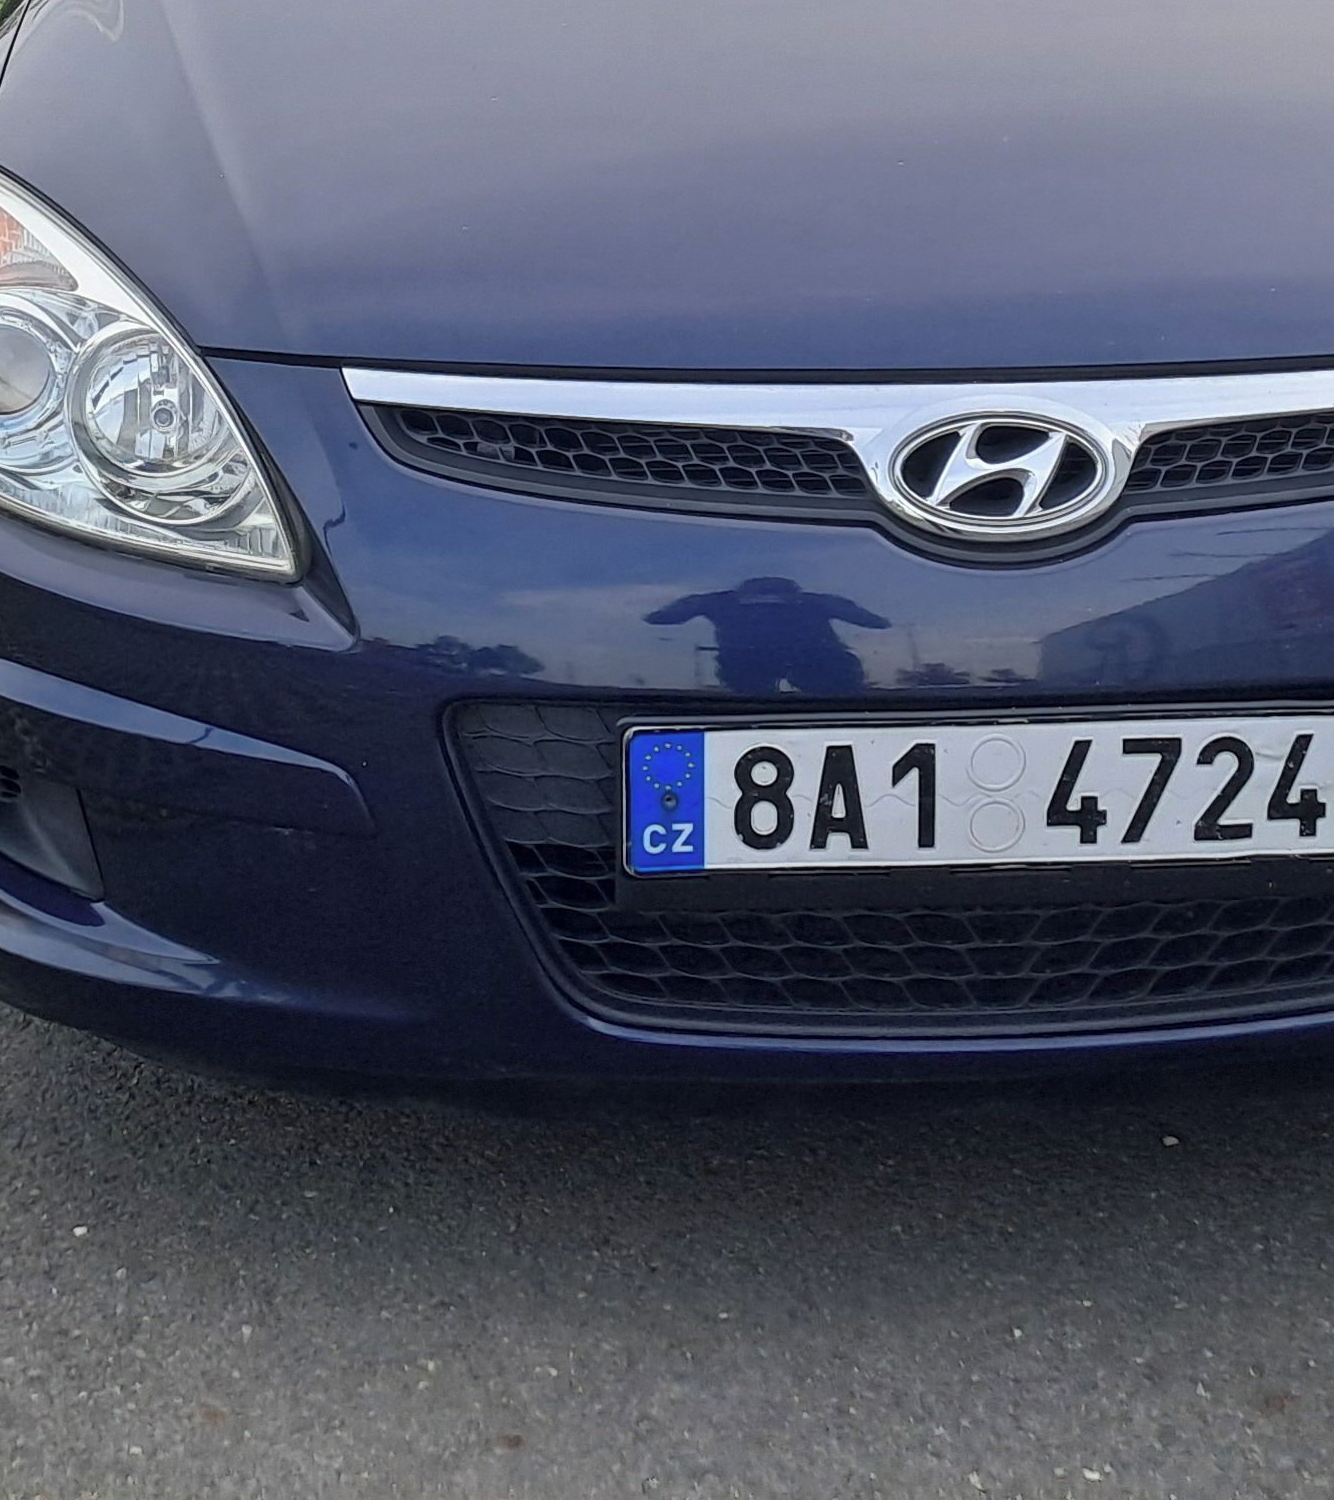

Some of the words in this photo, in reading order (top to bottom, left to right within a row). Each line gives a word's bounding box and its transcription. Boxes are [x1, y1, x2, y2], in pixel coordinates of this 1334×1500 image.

[733, 742, 937, 851] 8A1
[1046, 733, 1327, 845] 4724
[642, 822, 695, 855] CZ
